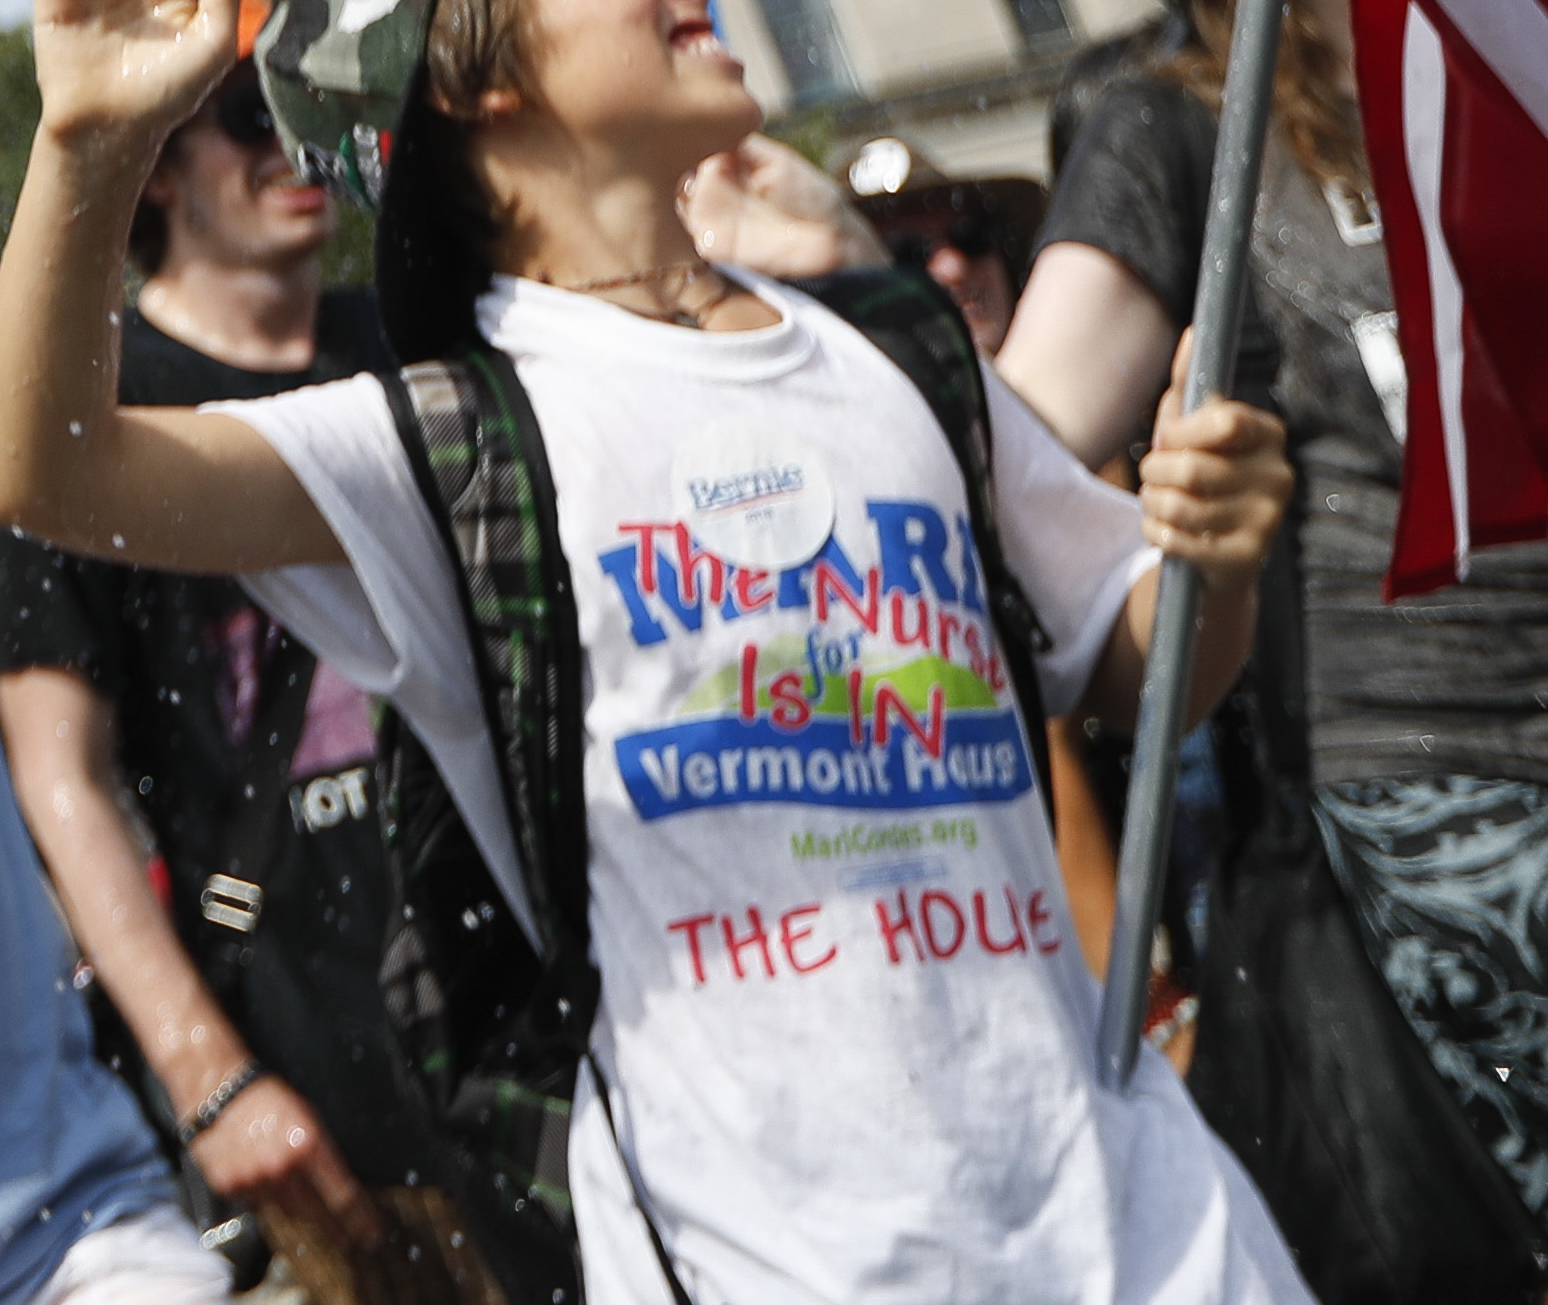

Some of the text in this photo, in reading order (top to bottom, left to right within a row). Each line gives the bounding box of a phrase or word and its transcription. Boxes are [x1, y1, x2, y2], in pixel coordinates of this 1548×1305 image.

[689, 462, 804, 511] Bernie
[739, 642, 944, 760] Is IN
[806, 625, 863, 701] for
[639, 743, 892, 802] Vermont
[667, 902, 839, 984] THE
